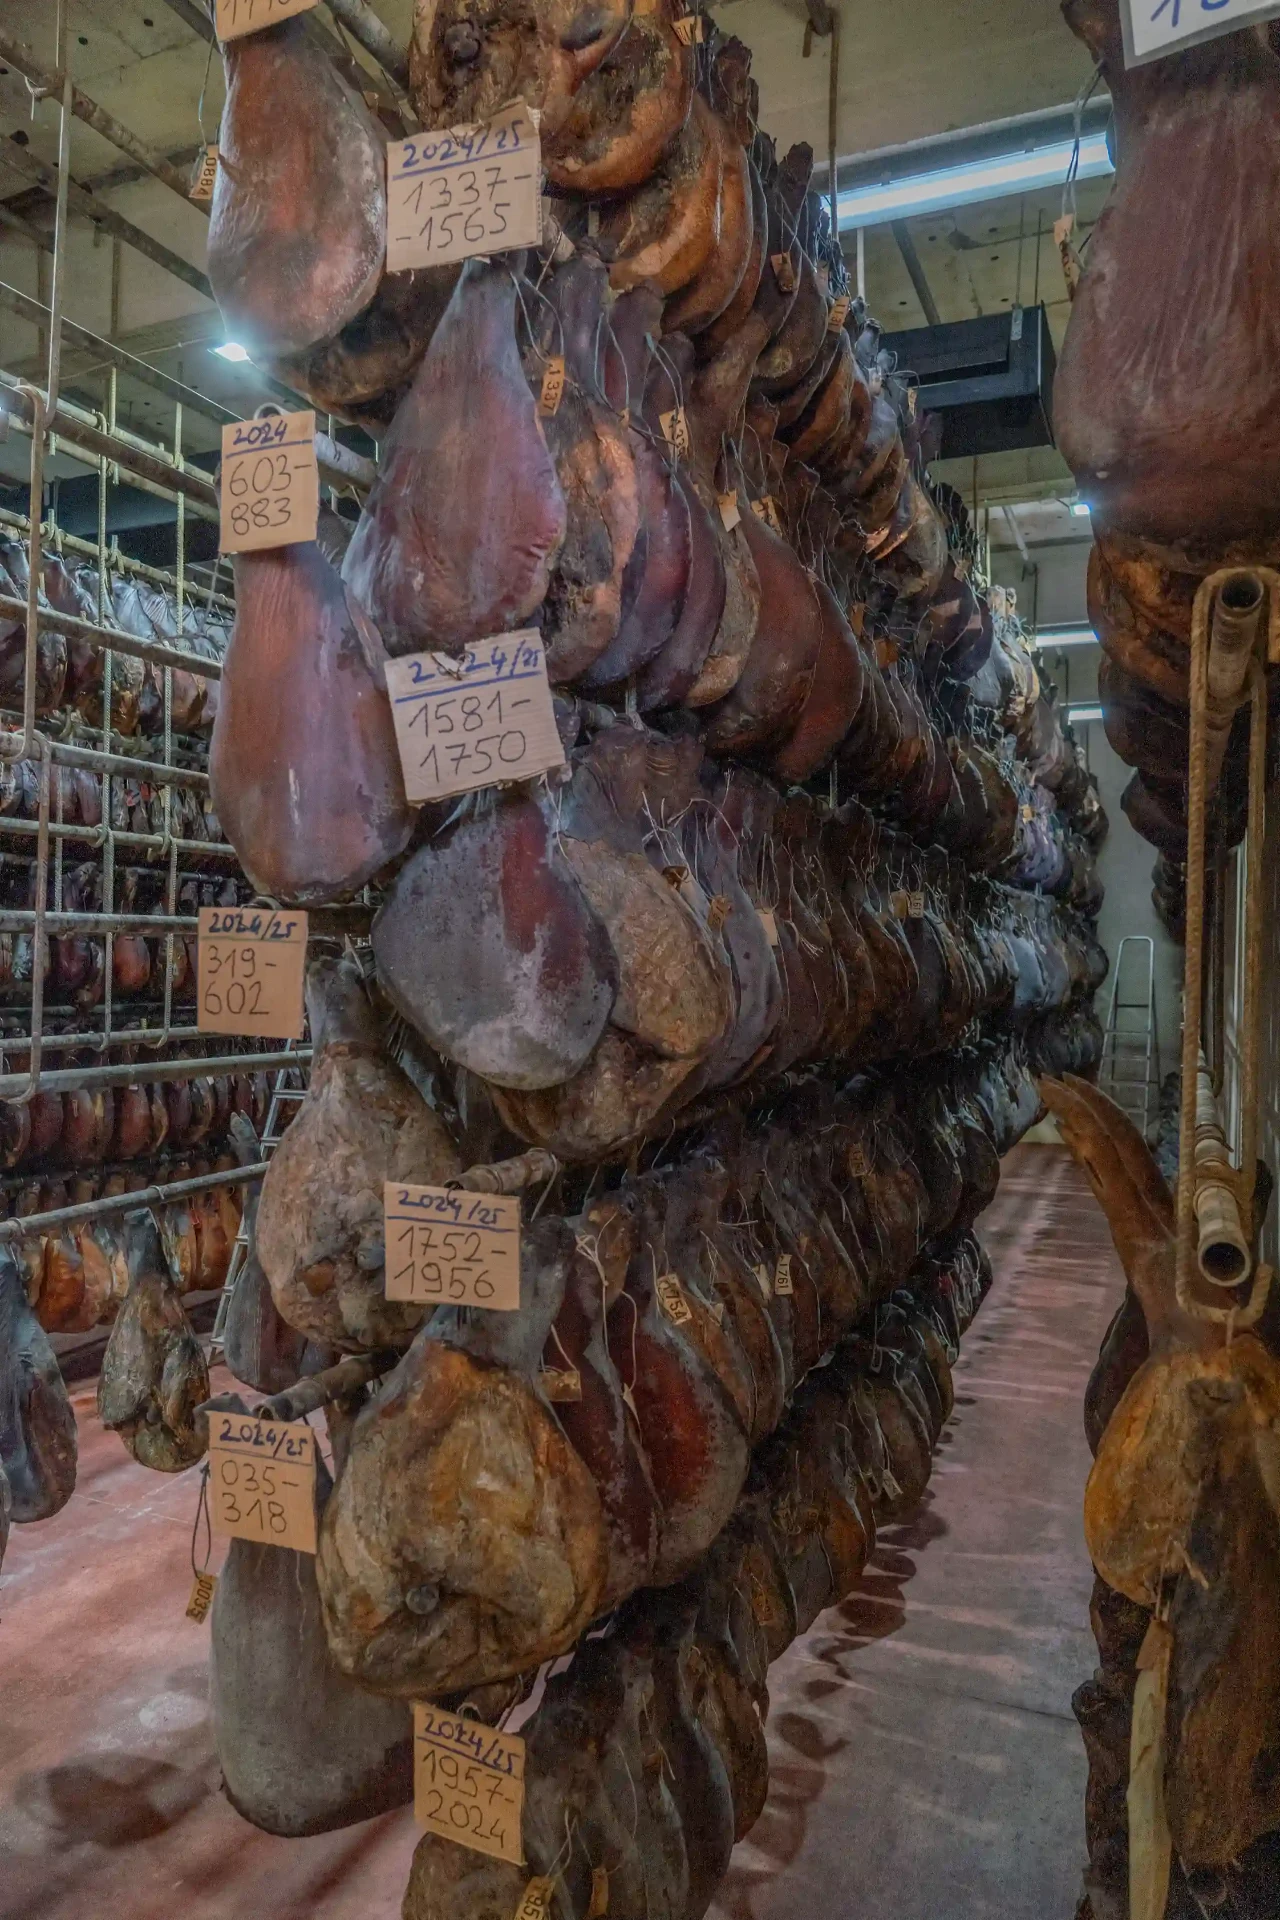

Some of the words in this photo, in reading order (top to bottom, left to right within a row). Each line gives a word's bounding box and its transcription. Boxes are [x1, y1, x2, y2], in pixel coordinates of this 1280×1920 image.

[402, 119, 524, 168] 2024/25
[197, 157, 217, 195] 0884
[403, 167, 532, 214] 1337-
[543, 369, 561, 411] 1337
[233, 419, 288, 445] 2024
[230, 497, 291, 536] 883
[408, 690, 531, 737] 1581-
[419, 730, 526, 783] 1750
[208, 911, 297, 940] 2024/25
[204, 981, 270, 1015] 602
[398, 1190, 506, 1224] 2024/25
[394, 1260, 496, 1299] 1956
[777, 1263, 789, 1289] 1761
[219, 1418, 308, 1458] 2024/25
[222, 1492, 287, 1533] 318
[189, 1579, 213, 1622] 0035
[424, 1713, 520, 1774] 2024/25
[426, 1789, 507, 1849] 2024
